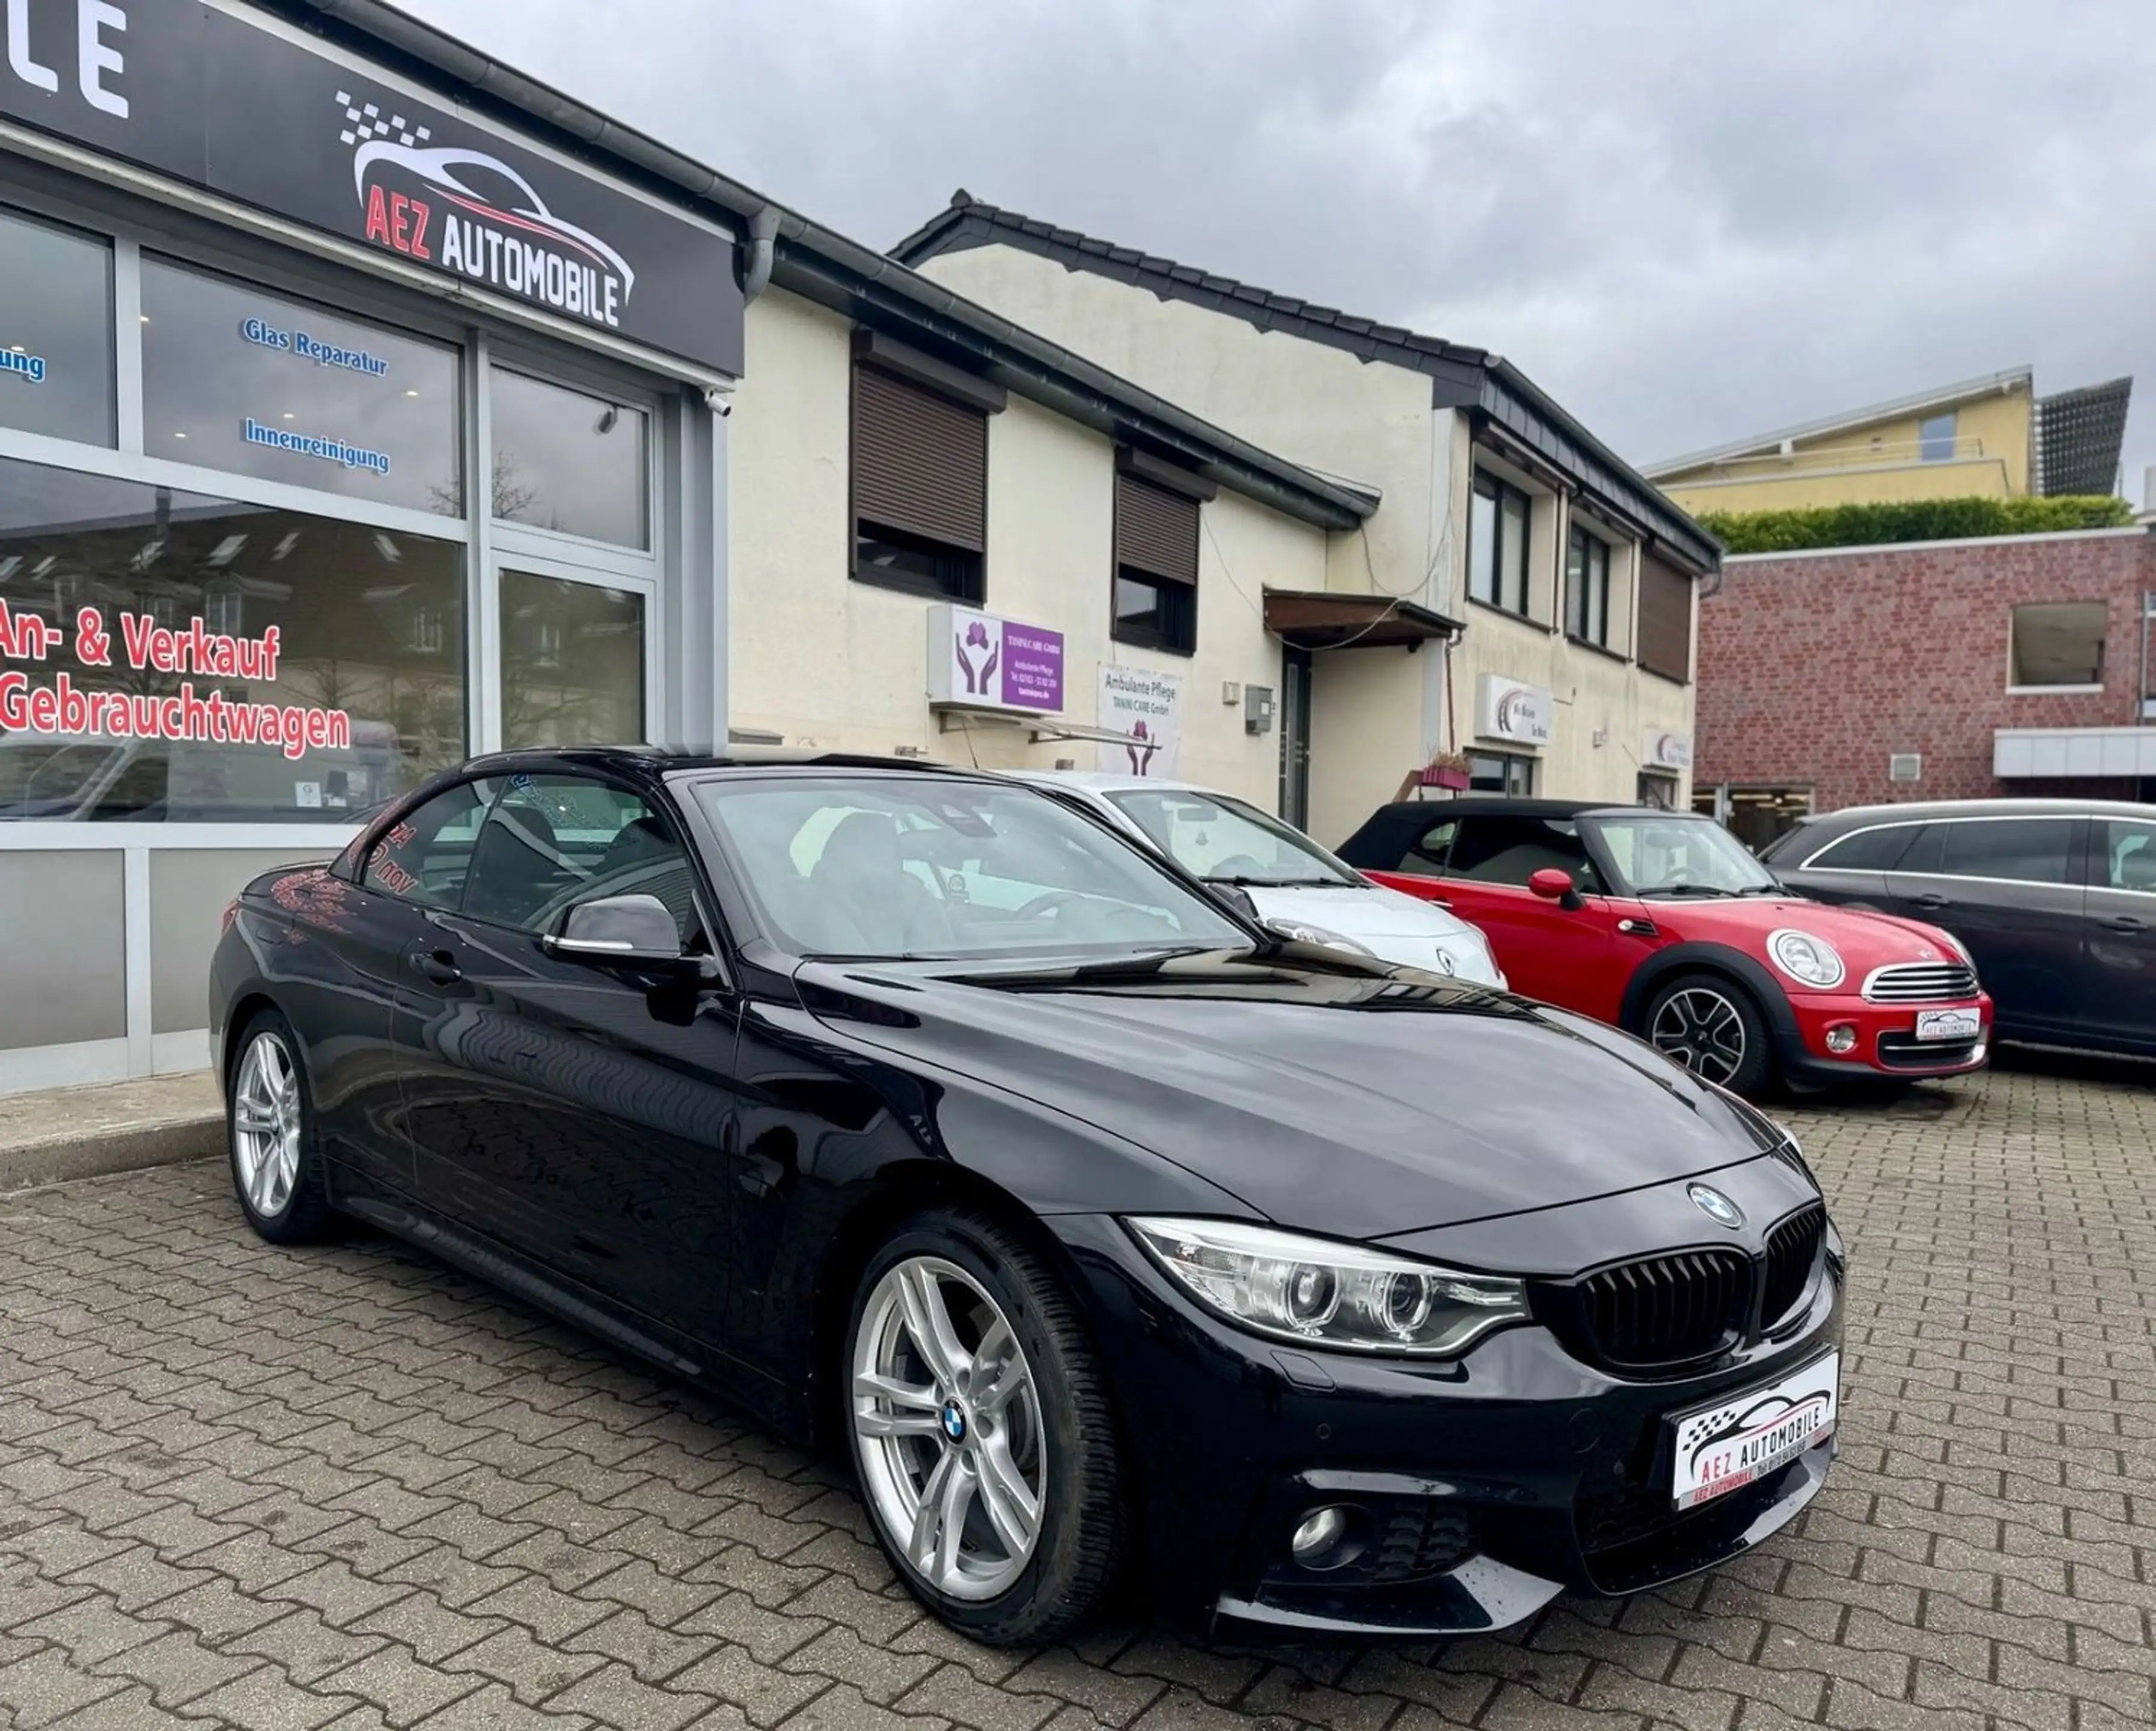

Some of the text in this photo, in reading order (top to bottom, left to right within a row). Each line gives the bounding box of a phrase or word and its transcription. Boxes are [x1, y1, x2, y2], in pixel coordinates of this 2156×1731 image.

[365, 184, 619, 327] AEZ AUTOMOBILE
[244, 317, 388, 377] Glas Reparatur
[246, 417, 390, 475] Innenreinigung
[76, 606, 112, 665] &
[121, 612, 280, 680] Verkauf
[0, 671, 350, 759] Gebrauchtwagen
[1105, 673, 1175, 703] Ambulante Pflege
[1702, 1452, 1731, 1483] AEZ
[1740, 1406, 1820, 1468] AUTOMOBILE
